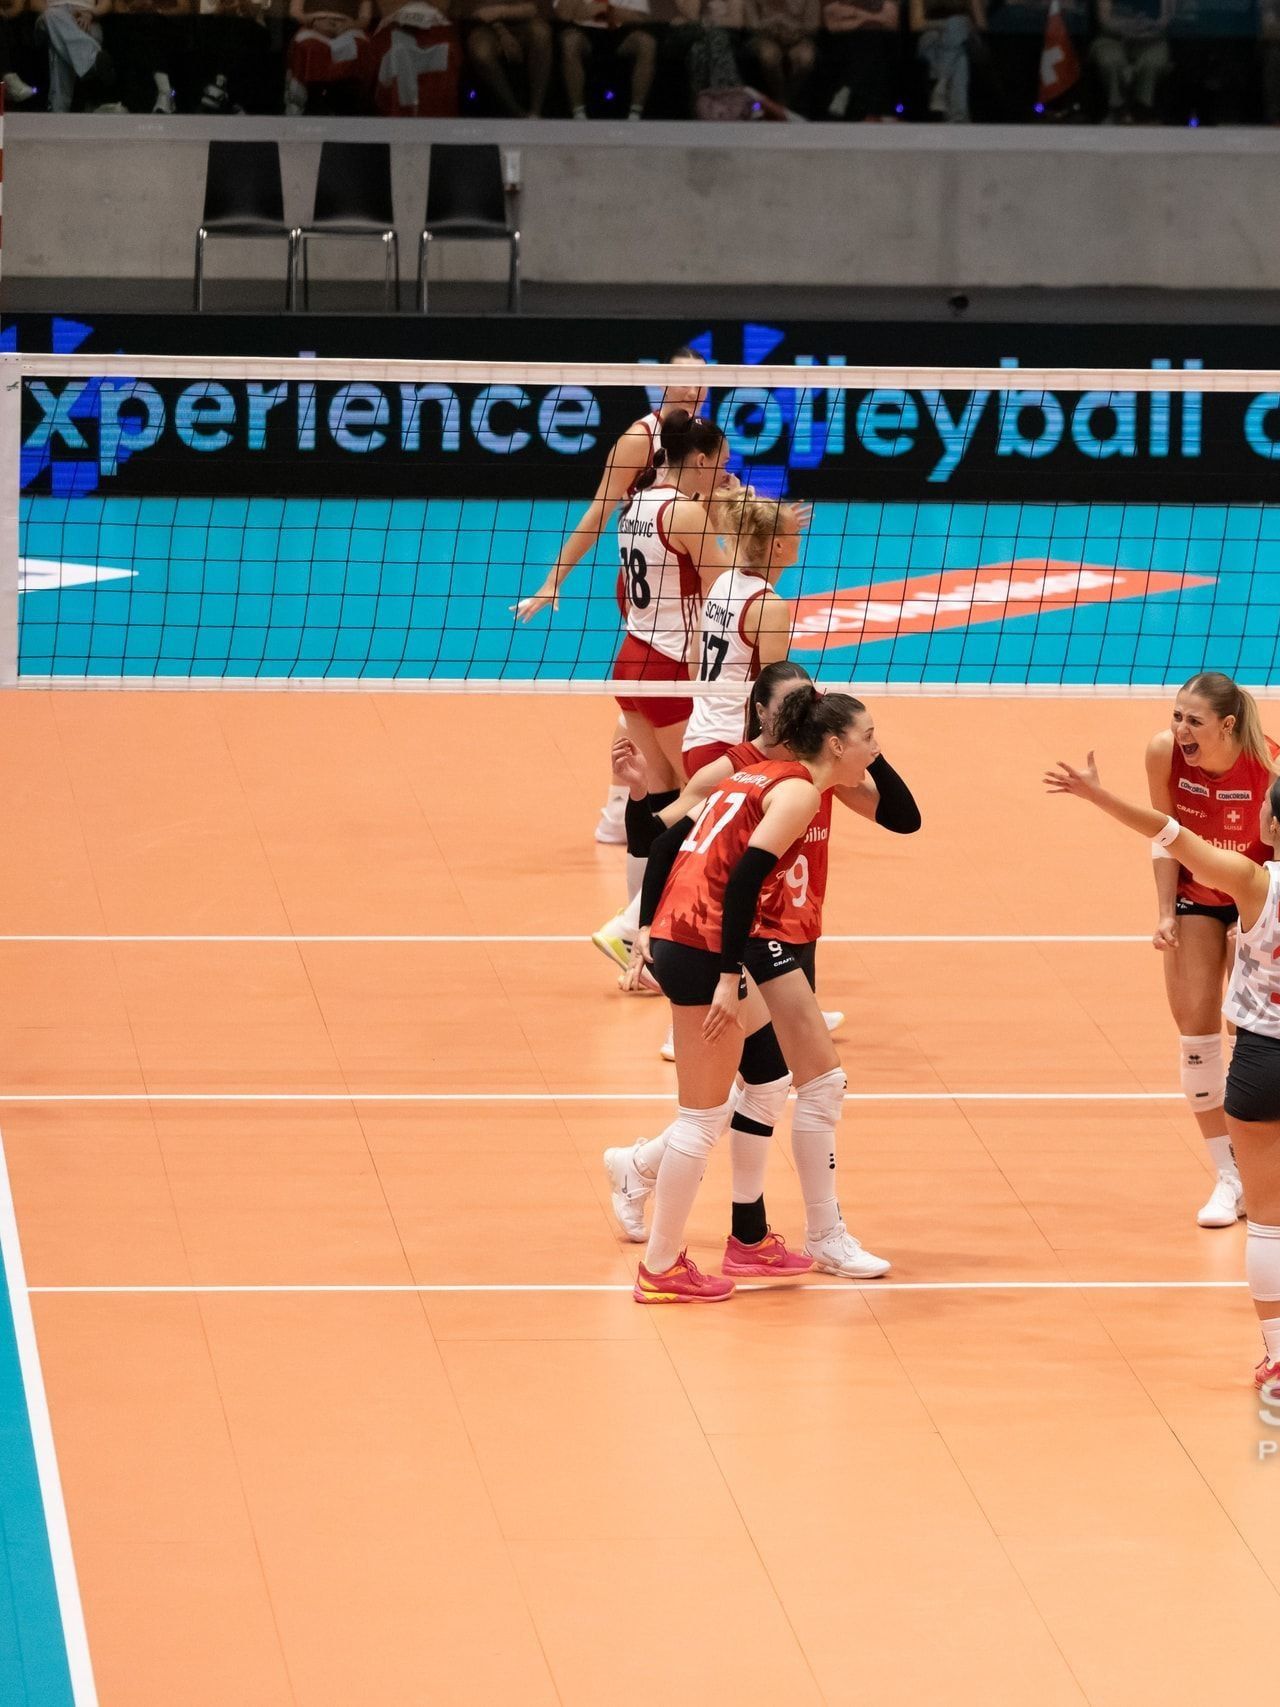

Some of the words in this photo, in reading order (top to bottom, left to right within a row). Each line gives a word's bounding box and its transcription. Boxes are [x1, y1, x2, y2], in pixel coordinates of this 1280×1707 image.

[22, 351, 600, 476] xperience
[620, 547, 651, 610] 18
[700, 631, 730, 682] 17
[679, 789, 748, 855] 17
[785, 854, 809, 908] 9
[768, 940, 783, 958] 9
